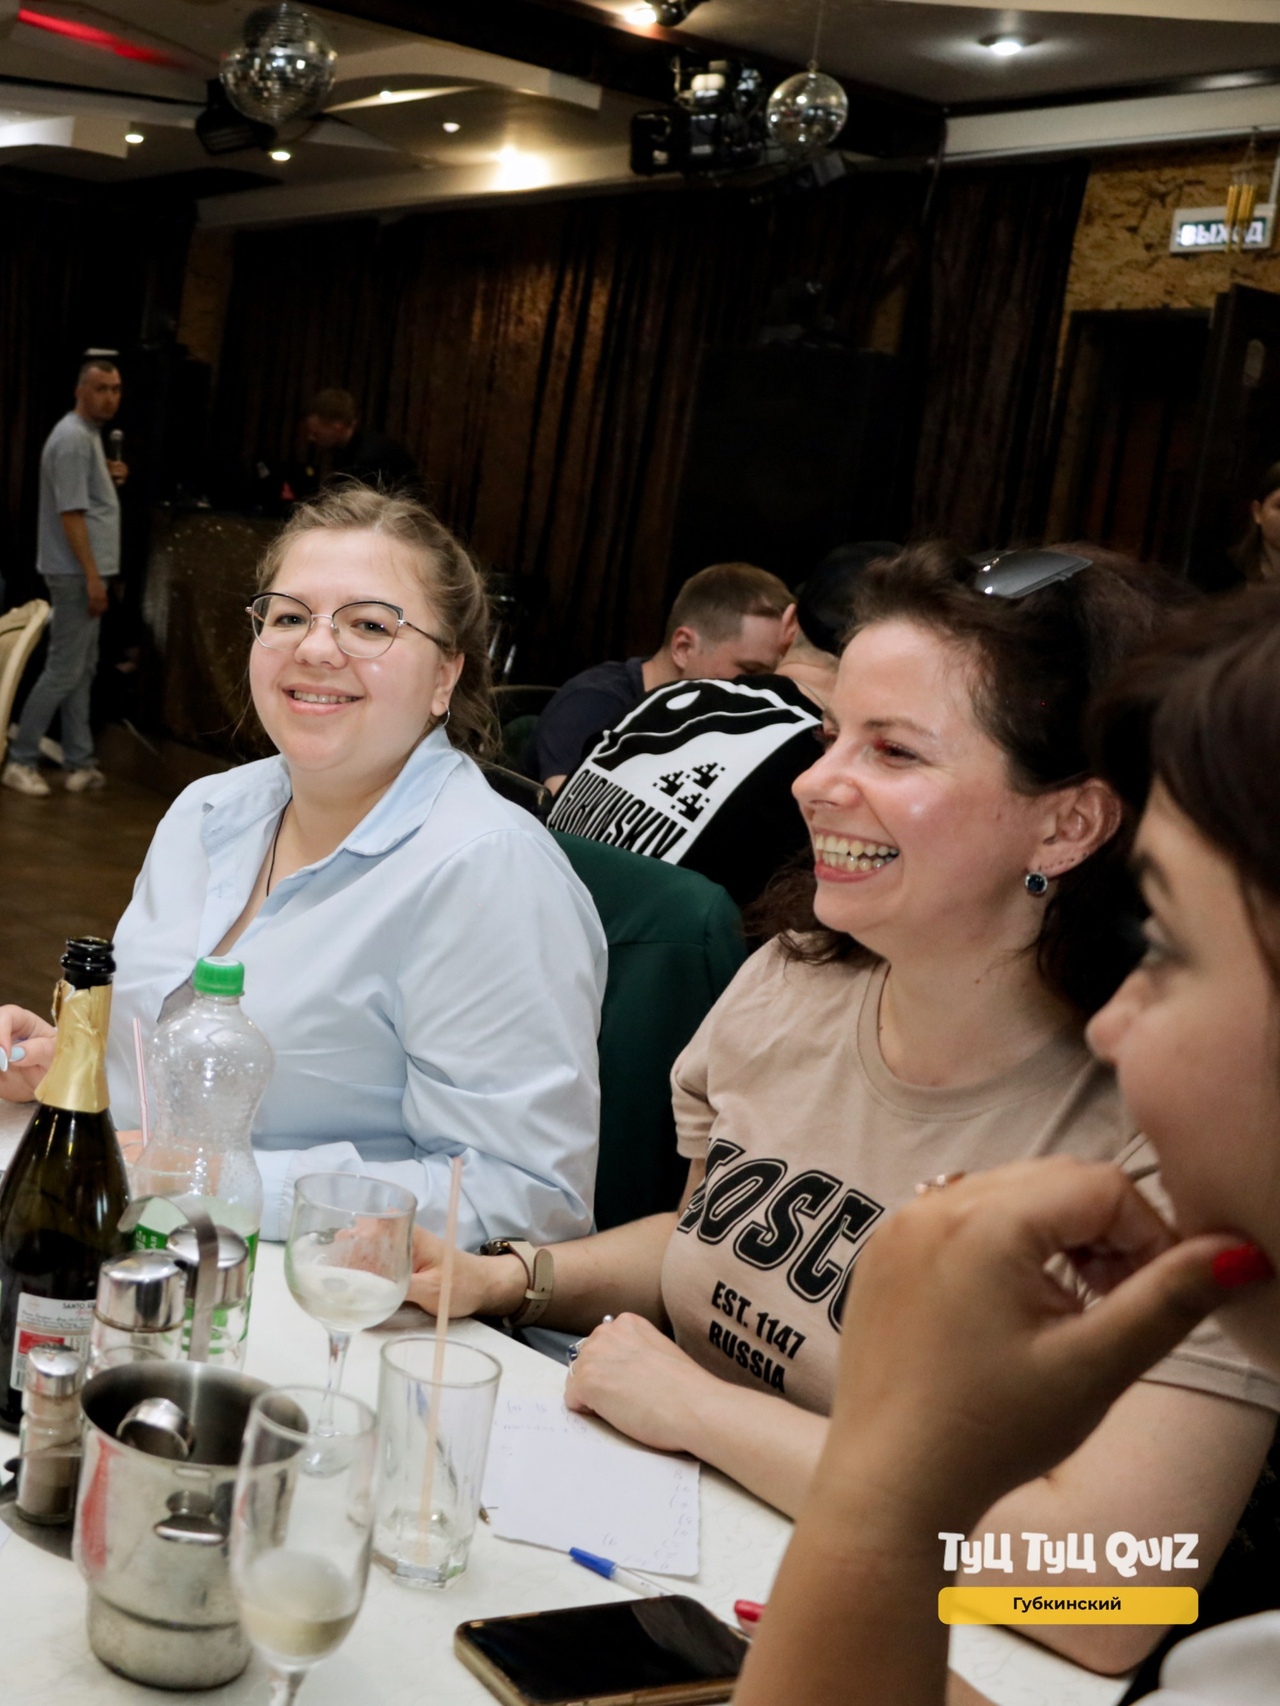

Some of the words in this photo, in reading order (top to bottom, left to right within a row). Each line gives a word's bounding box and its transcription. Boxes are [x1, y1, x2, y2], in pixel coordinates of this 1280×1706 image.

[708, 1320, 786, 1394] RUSSIA
[711, 1281, 751, 1328] EST.
[757, 1311, 806, 1360] 1147
